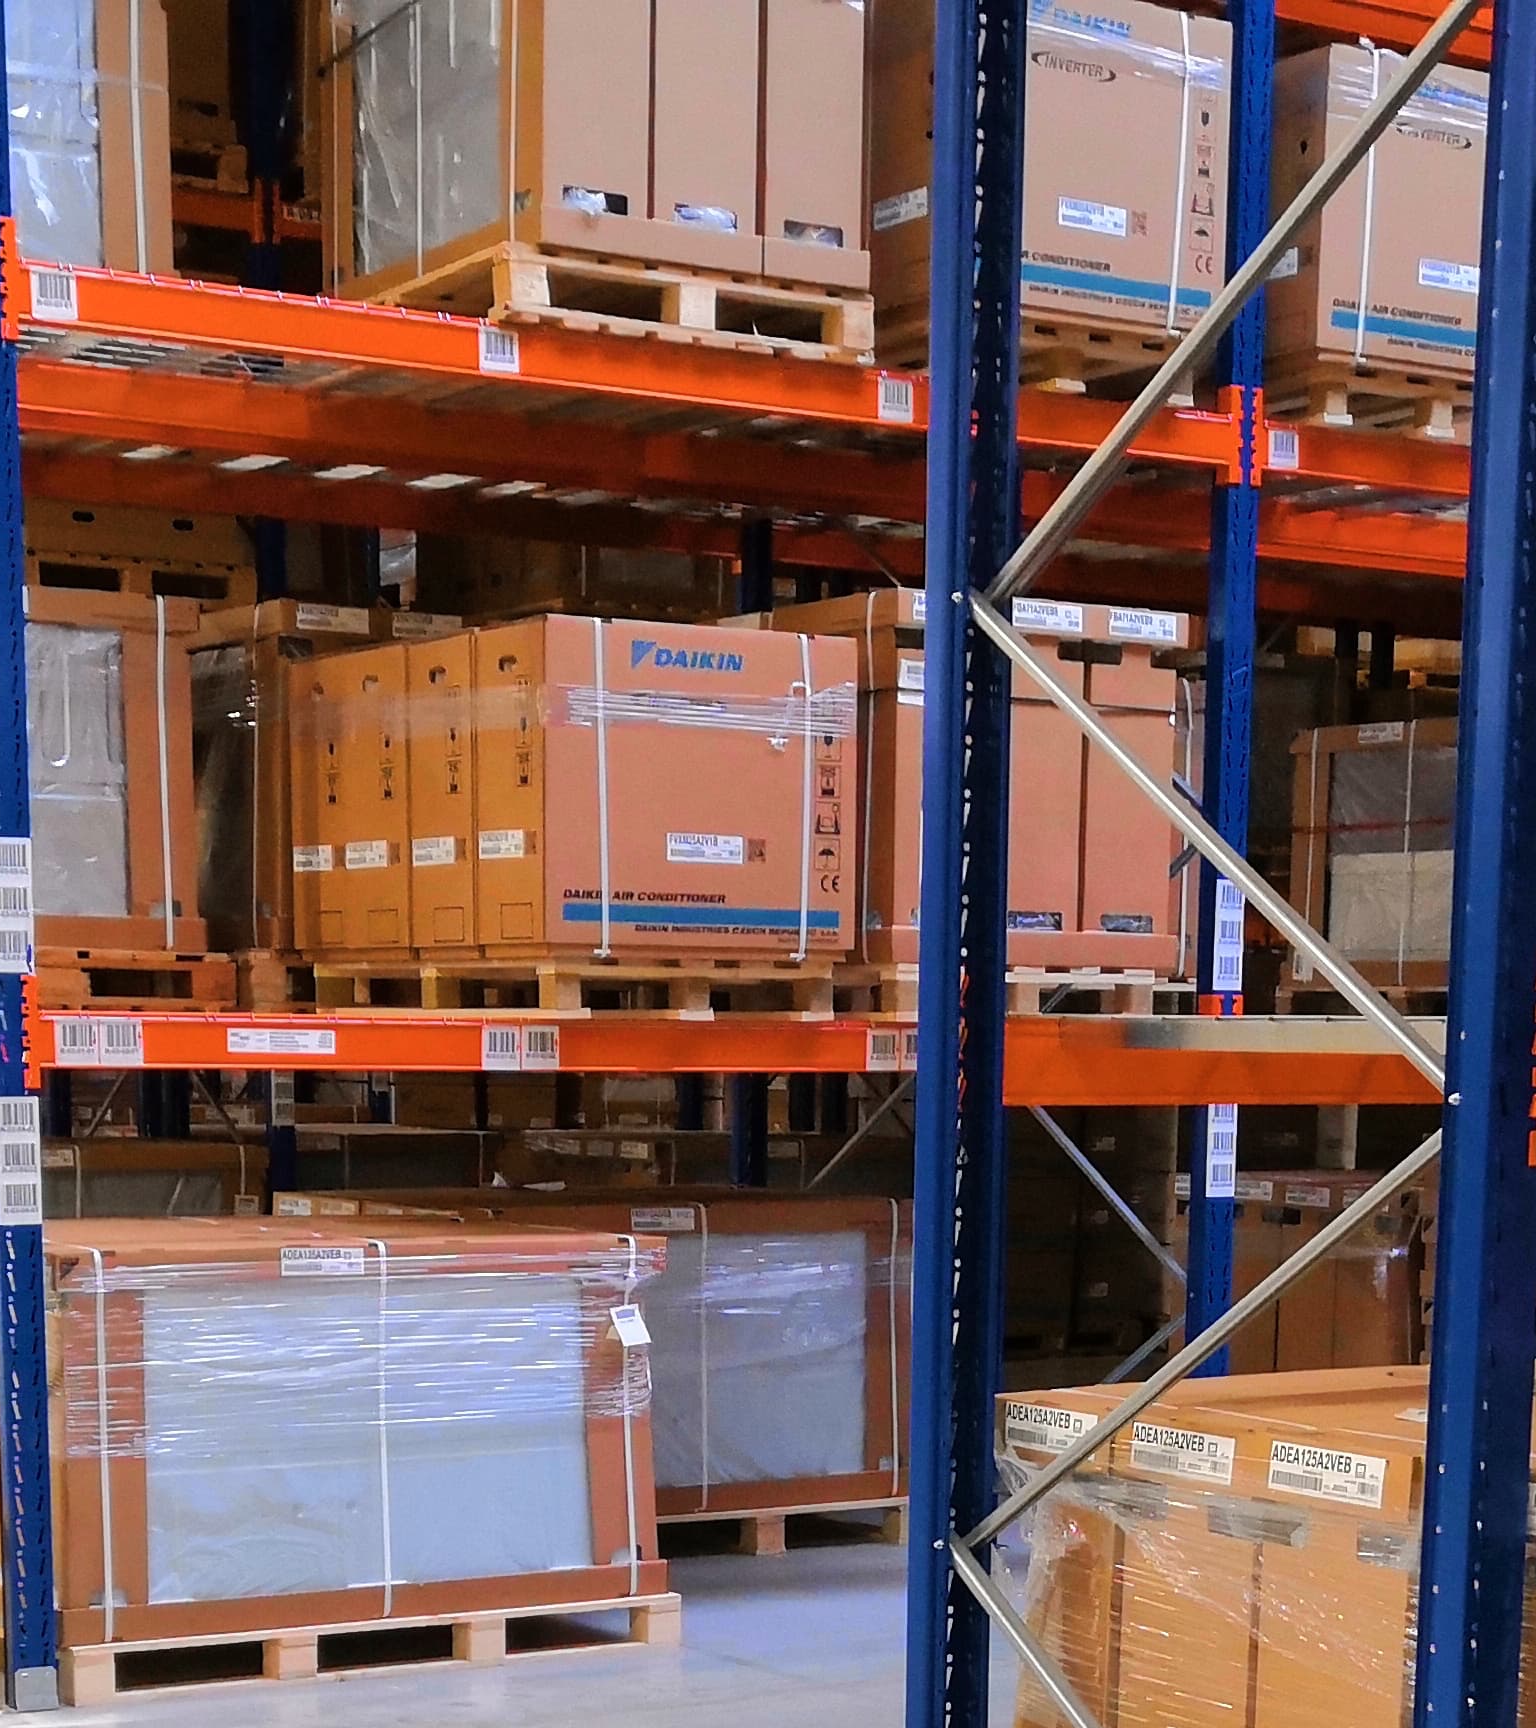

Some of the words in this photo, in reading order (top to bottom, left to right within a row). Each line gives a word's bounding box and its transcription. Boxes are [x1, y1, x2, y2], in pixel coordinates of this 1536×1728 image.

[1044, 54, 1103, 77] INVERTER
[654, 648, 743, 671] DAIKIN
[612, 891, 634, 900] AIR
[638, 892, 727, 904] CONDITIONER
[1006, 1405, 1071, 1430] ADEA125A2VEB
[1134, 1424, 1205, 1452] ADEA125A2VEB
[1271, 1444, 1352, 1474] ADEA125A2VEB
